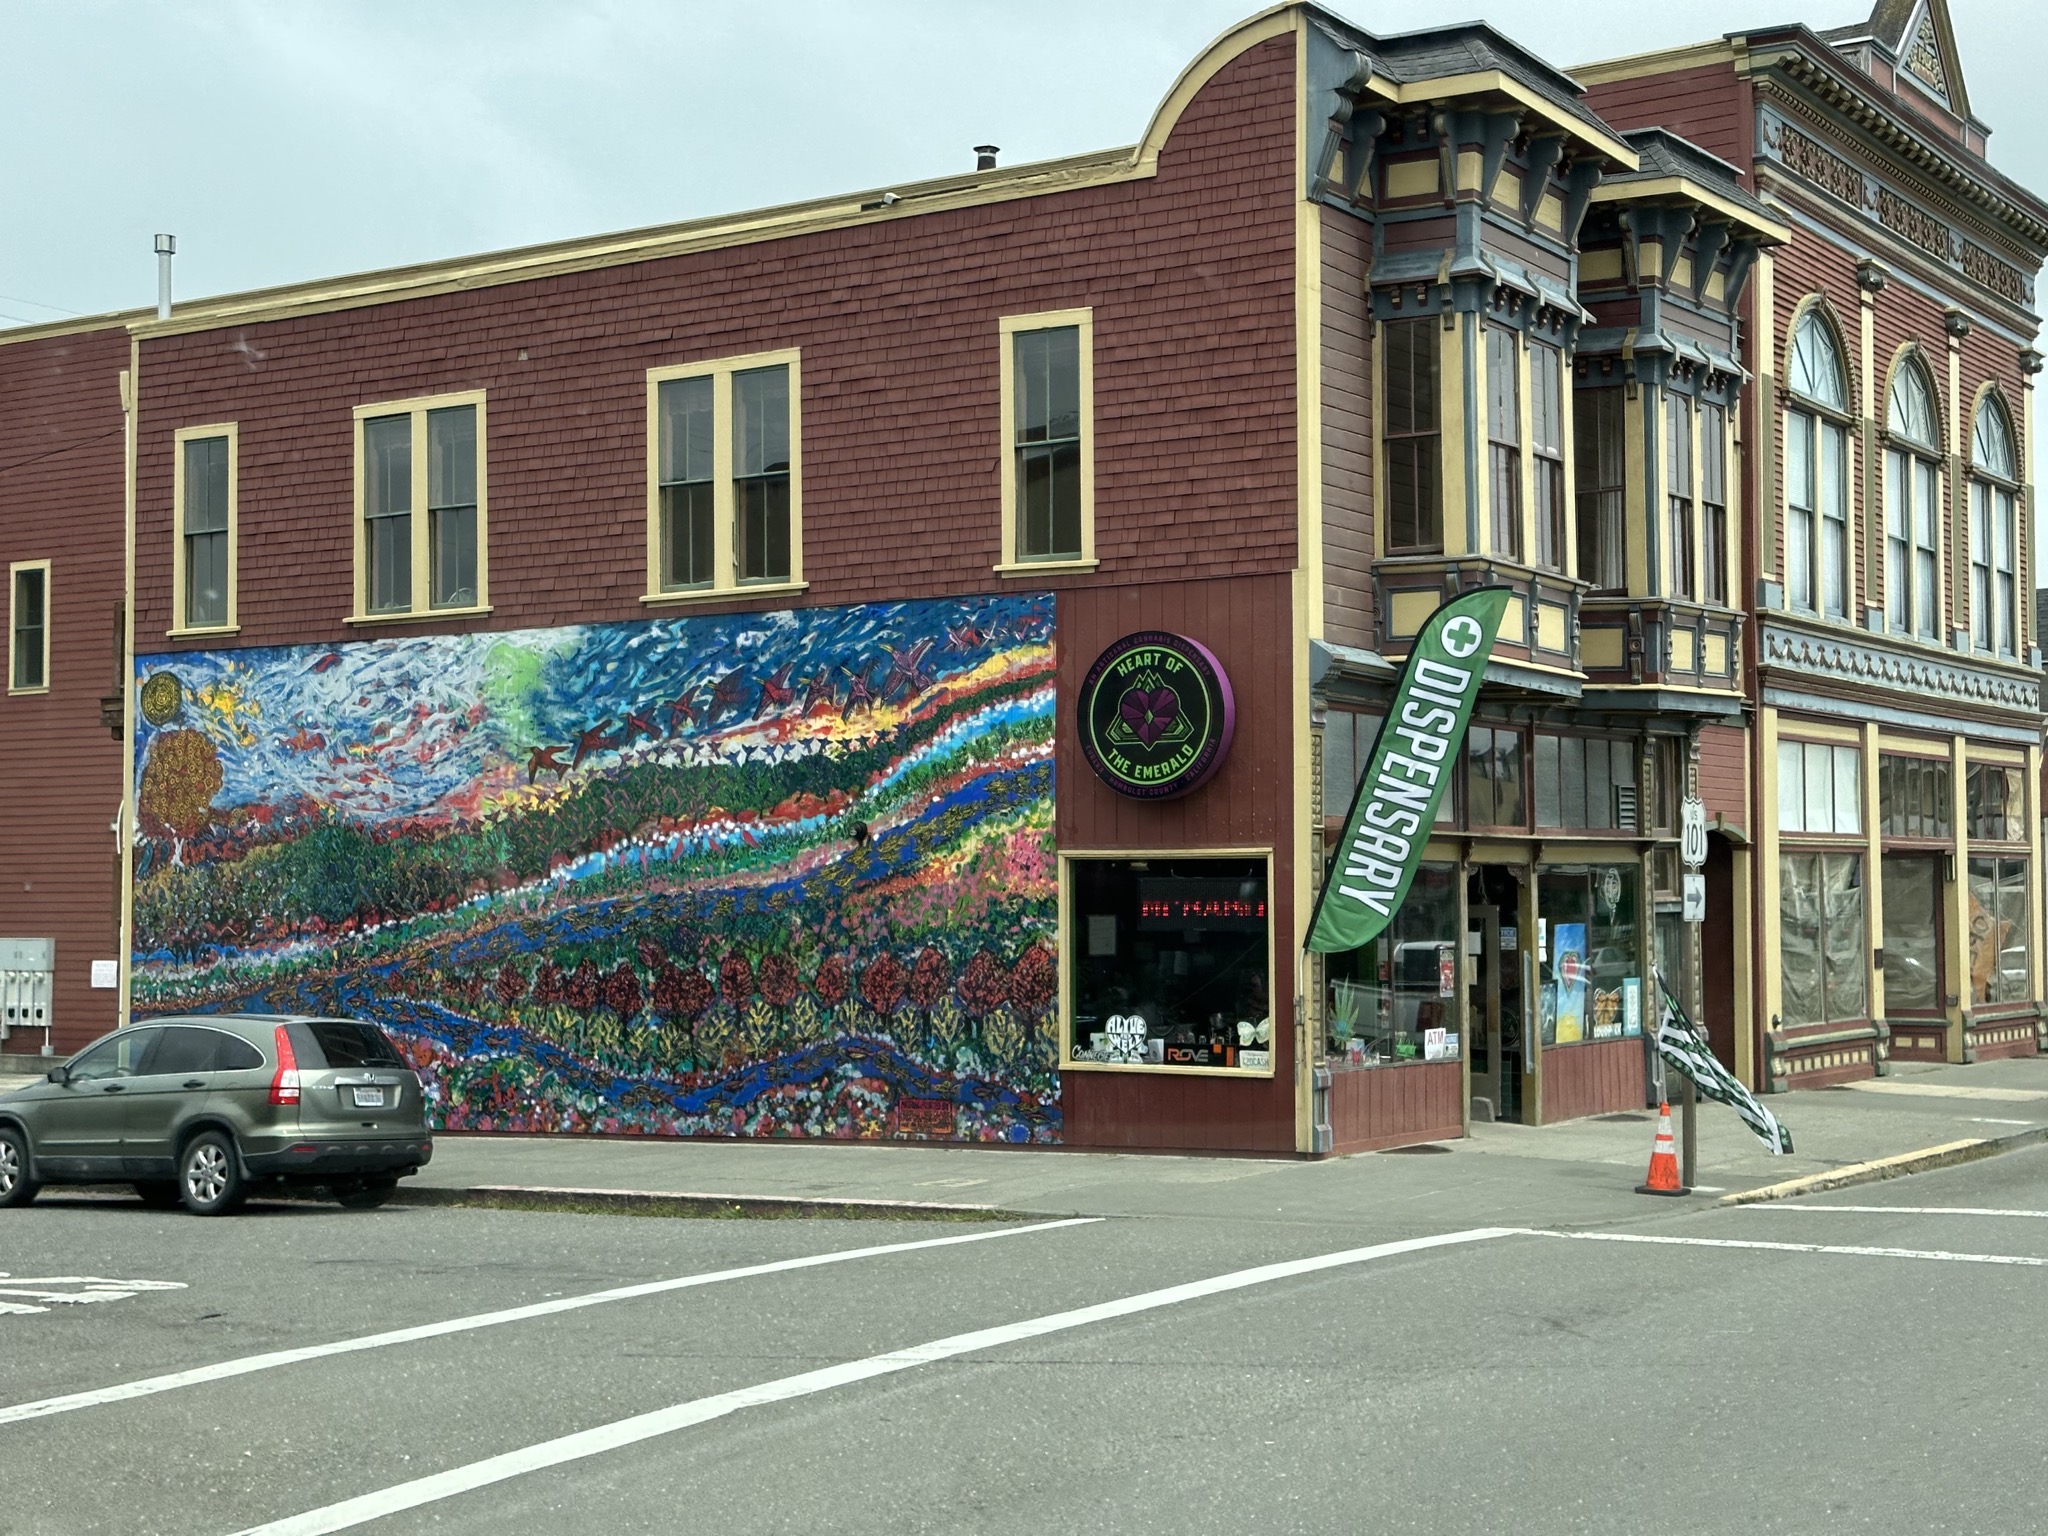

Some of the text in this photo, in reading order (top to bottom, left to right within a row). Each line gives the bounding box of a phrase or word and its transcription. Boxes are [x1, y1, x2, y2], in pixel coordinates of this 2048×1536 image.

[1088, 634, 1212, 686] AN ARTISANAL CANNABIS DISPENSARY
[1116, 652, 1184, 677] HEART OF
[1085, 744, 1105, 773] EUREKA
[1149, 783, 1179, 796] COUNTY
[1185, 738, 1217, 781] CALIFORNIA
[1108, 743, 1194, 779] THE EMERALD
[1338, 657, 1472, 918] DISPENSARY
[1690, 810, 1698, 820] US
[1686, 823, 1702, 856] 101
[1167, 1048, 1208, 1062] ROVE
[1427, 1031, 1443, 1046] ATM
